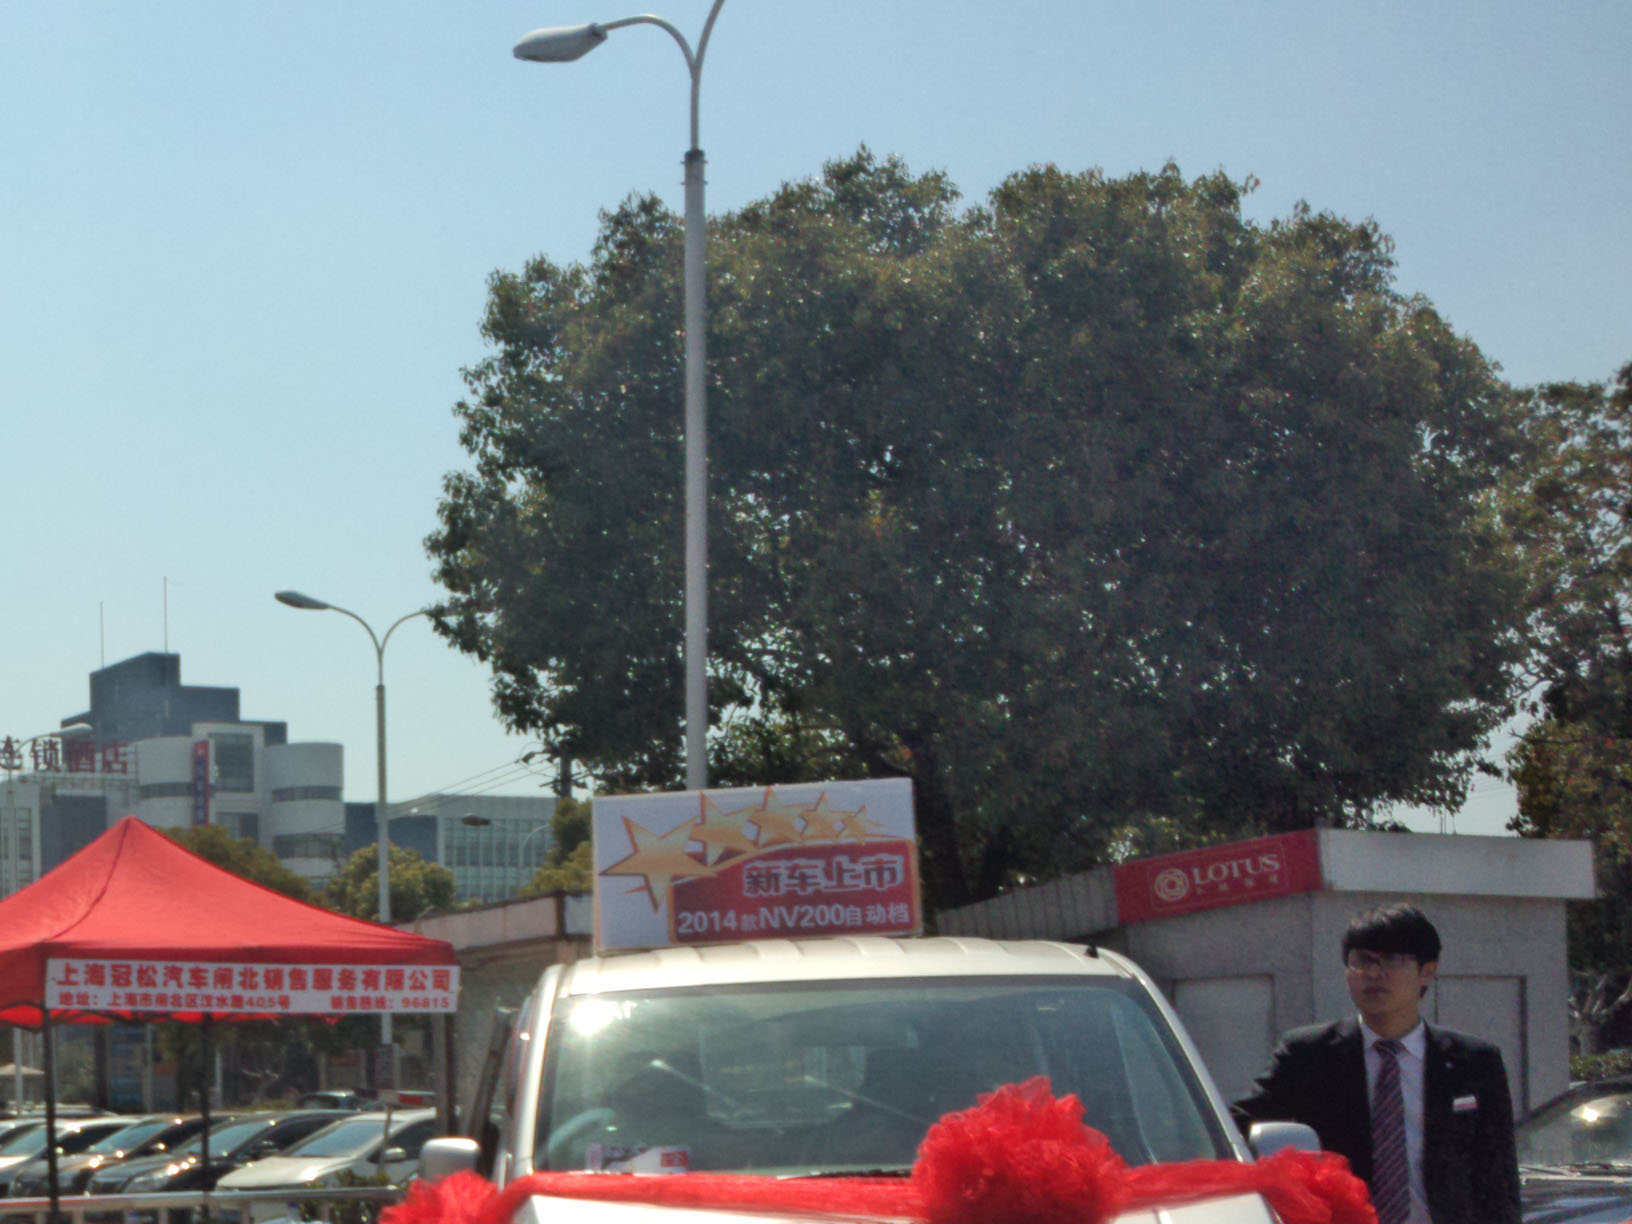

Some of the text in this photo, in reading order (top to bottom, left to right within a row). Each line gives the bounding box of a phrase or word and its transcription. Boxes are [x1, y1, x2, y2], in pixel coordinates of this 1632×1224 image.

[743, 854, 904, 897] 新车上市
[1192, 853, 1280, 885] LOTUS
